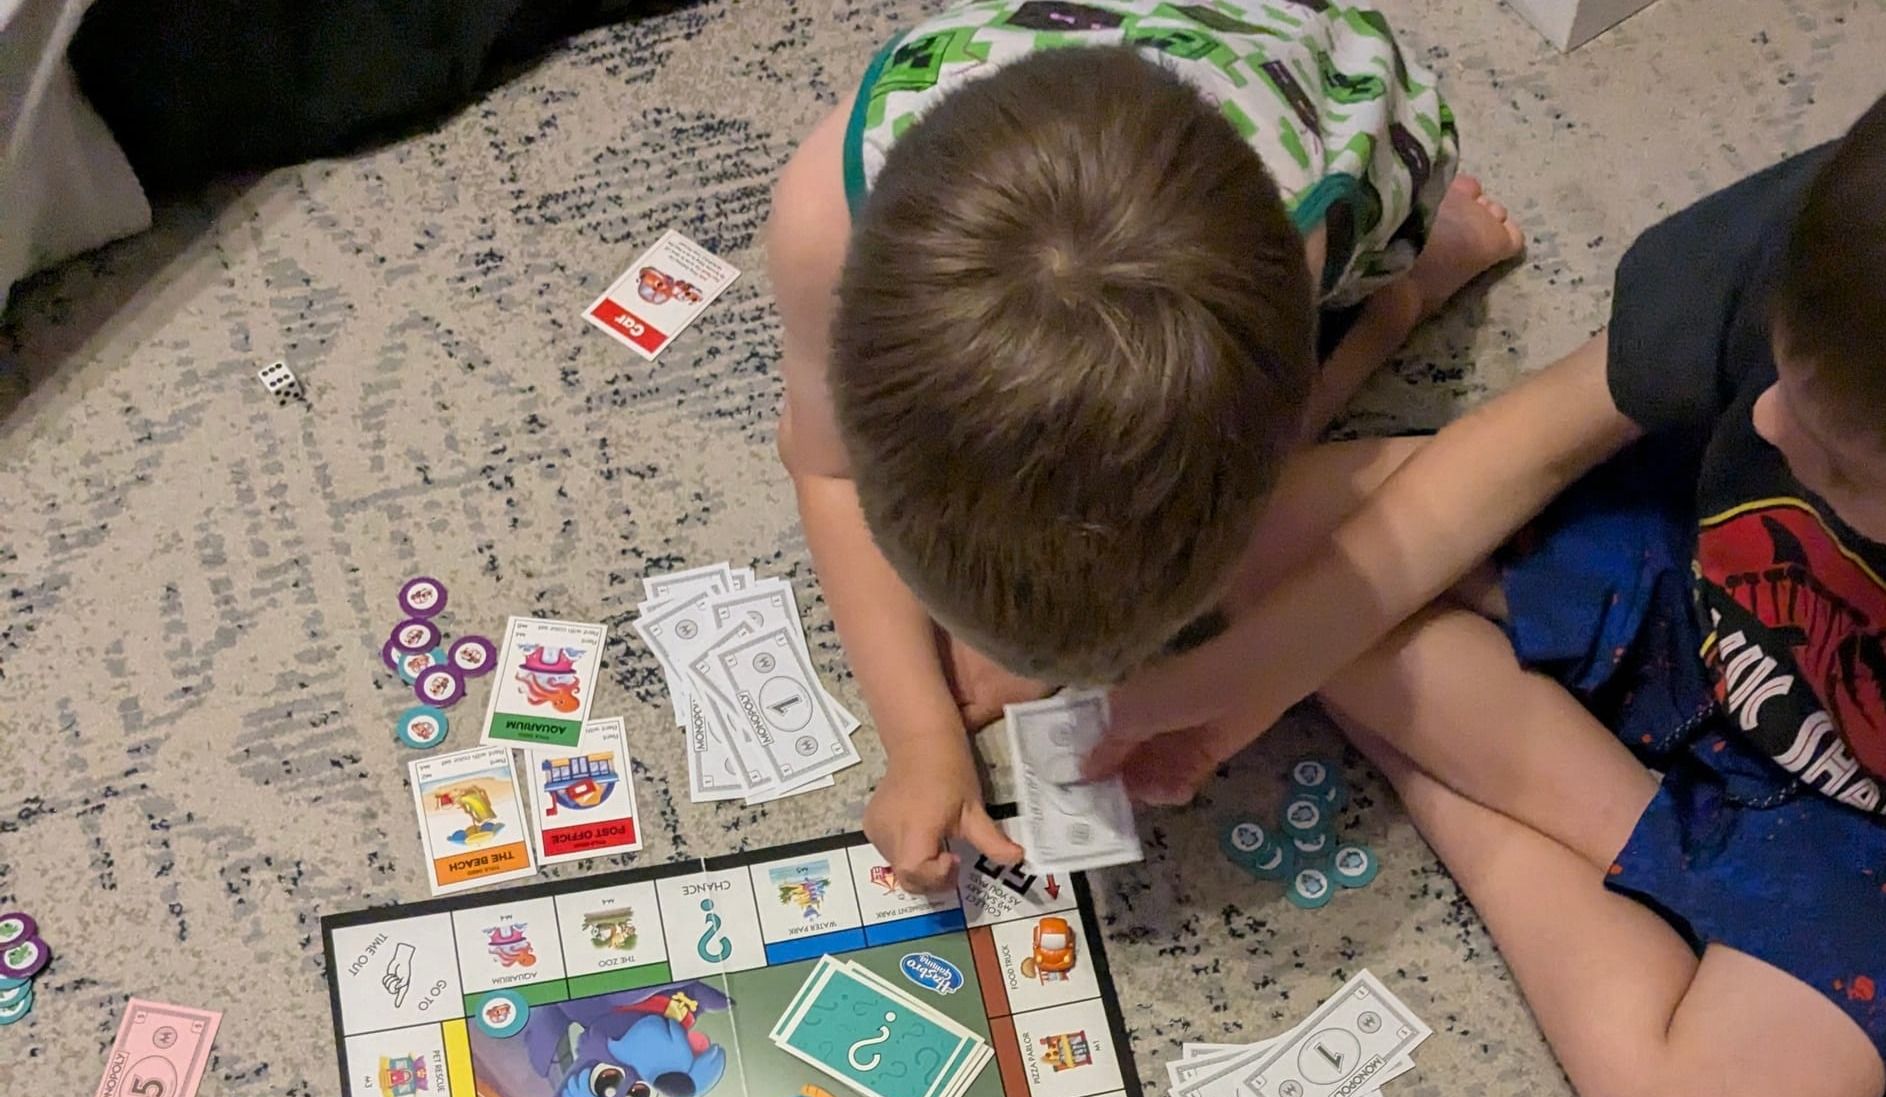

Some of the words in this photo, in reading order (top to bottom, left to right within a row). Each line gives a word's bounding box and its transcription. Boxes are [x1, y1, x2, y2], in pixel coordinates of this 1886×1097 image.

[766, 696, 801, 717] 1
[505, 718, 566, 736] AQUARIUM
[739, 692, 771, 744] MONOPOLY
[551, 829, 591, 845] OFFICE
[596, 823, 626, 837] POST
[448, 856, 488, 872] BEACH
[490, 850, 513, 863] THE
[681, 880, 731, 895] CHANCE
[788, 926, 810, 936] PARK
[812, 920, 838, 933] WATER
[366, 933, 388, 956] TIME
[598, 958, 618, 967] ZOO
[621, 955, 636, 963] THE
[1001, 944, 1012, 967] TRUCK
[348, 955, 368, 977] OUT
[492, 971, 537, 984] AQUARIUM
[907, 960, 953, 993] Hasbro
[1007, 968, 1019, 990] FOOD
[431, 979, 447, 997] GO
[418, 996, 434, 1011] TO
[1023, 1032, 1037, 1062] PARLOR
[432, 1049, 442, 1066] PET
[1315, 1042, 1344, 1074] 1
[435, 1066, 447, 1093] RESCUE
[1029, 1064, 1040, 1084] PIZZA
